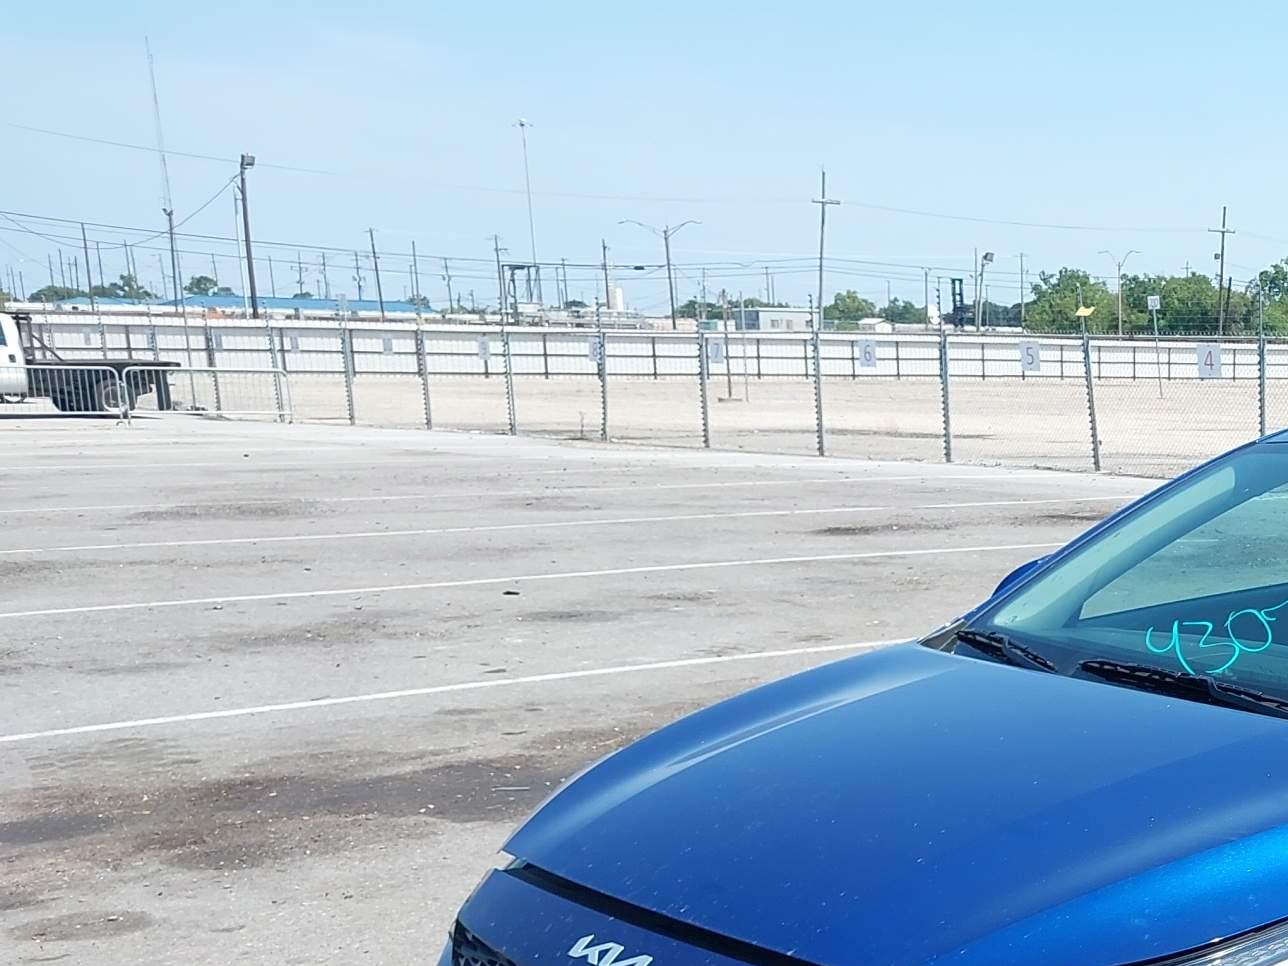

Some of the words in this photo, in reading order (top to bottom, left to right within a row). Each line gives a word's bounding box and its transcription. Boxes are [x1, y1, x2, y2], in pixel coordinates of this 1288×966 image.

[863, 344, 872, 362] 6
[1026, 346, 1034, 365] 5
[1204, 350, 1215, 371] 4
